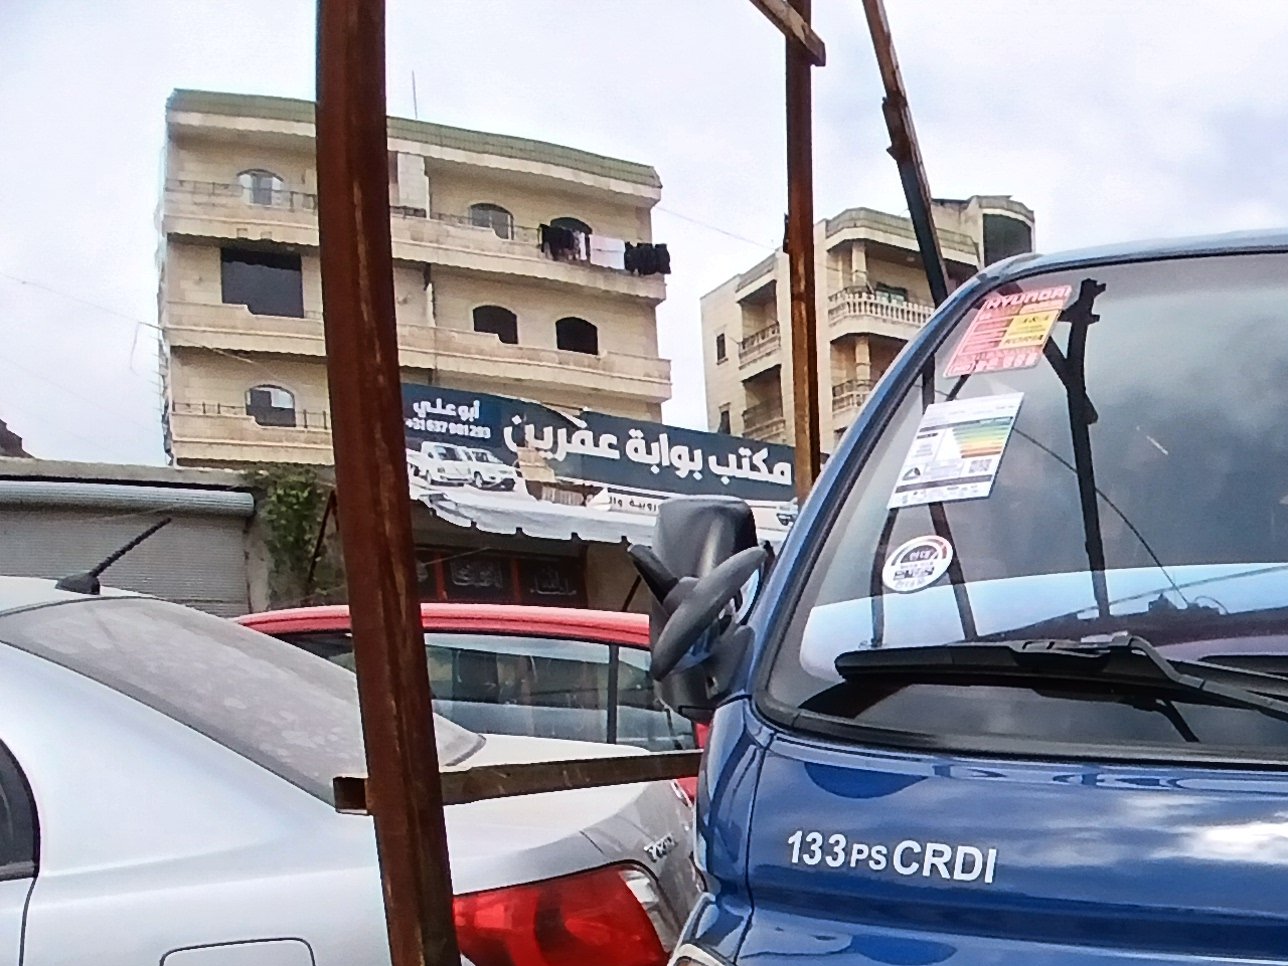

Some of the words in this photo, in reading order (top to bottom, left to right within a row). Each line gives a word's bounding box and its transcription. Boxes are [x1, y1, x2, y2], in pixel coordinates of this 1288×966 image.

[503, 414, 621, 463] عفرين
[625, 428, 704, 480] بوابة
[707, 446, 793, 486] مكتب
